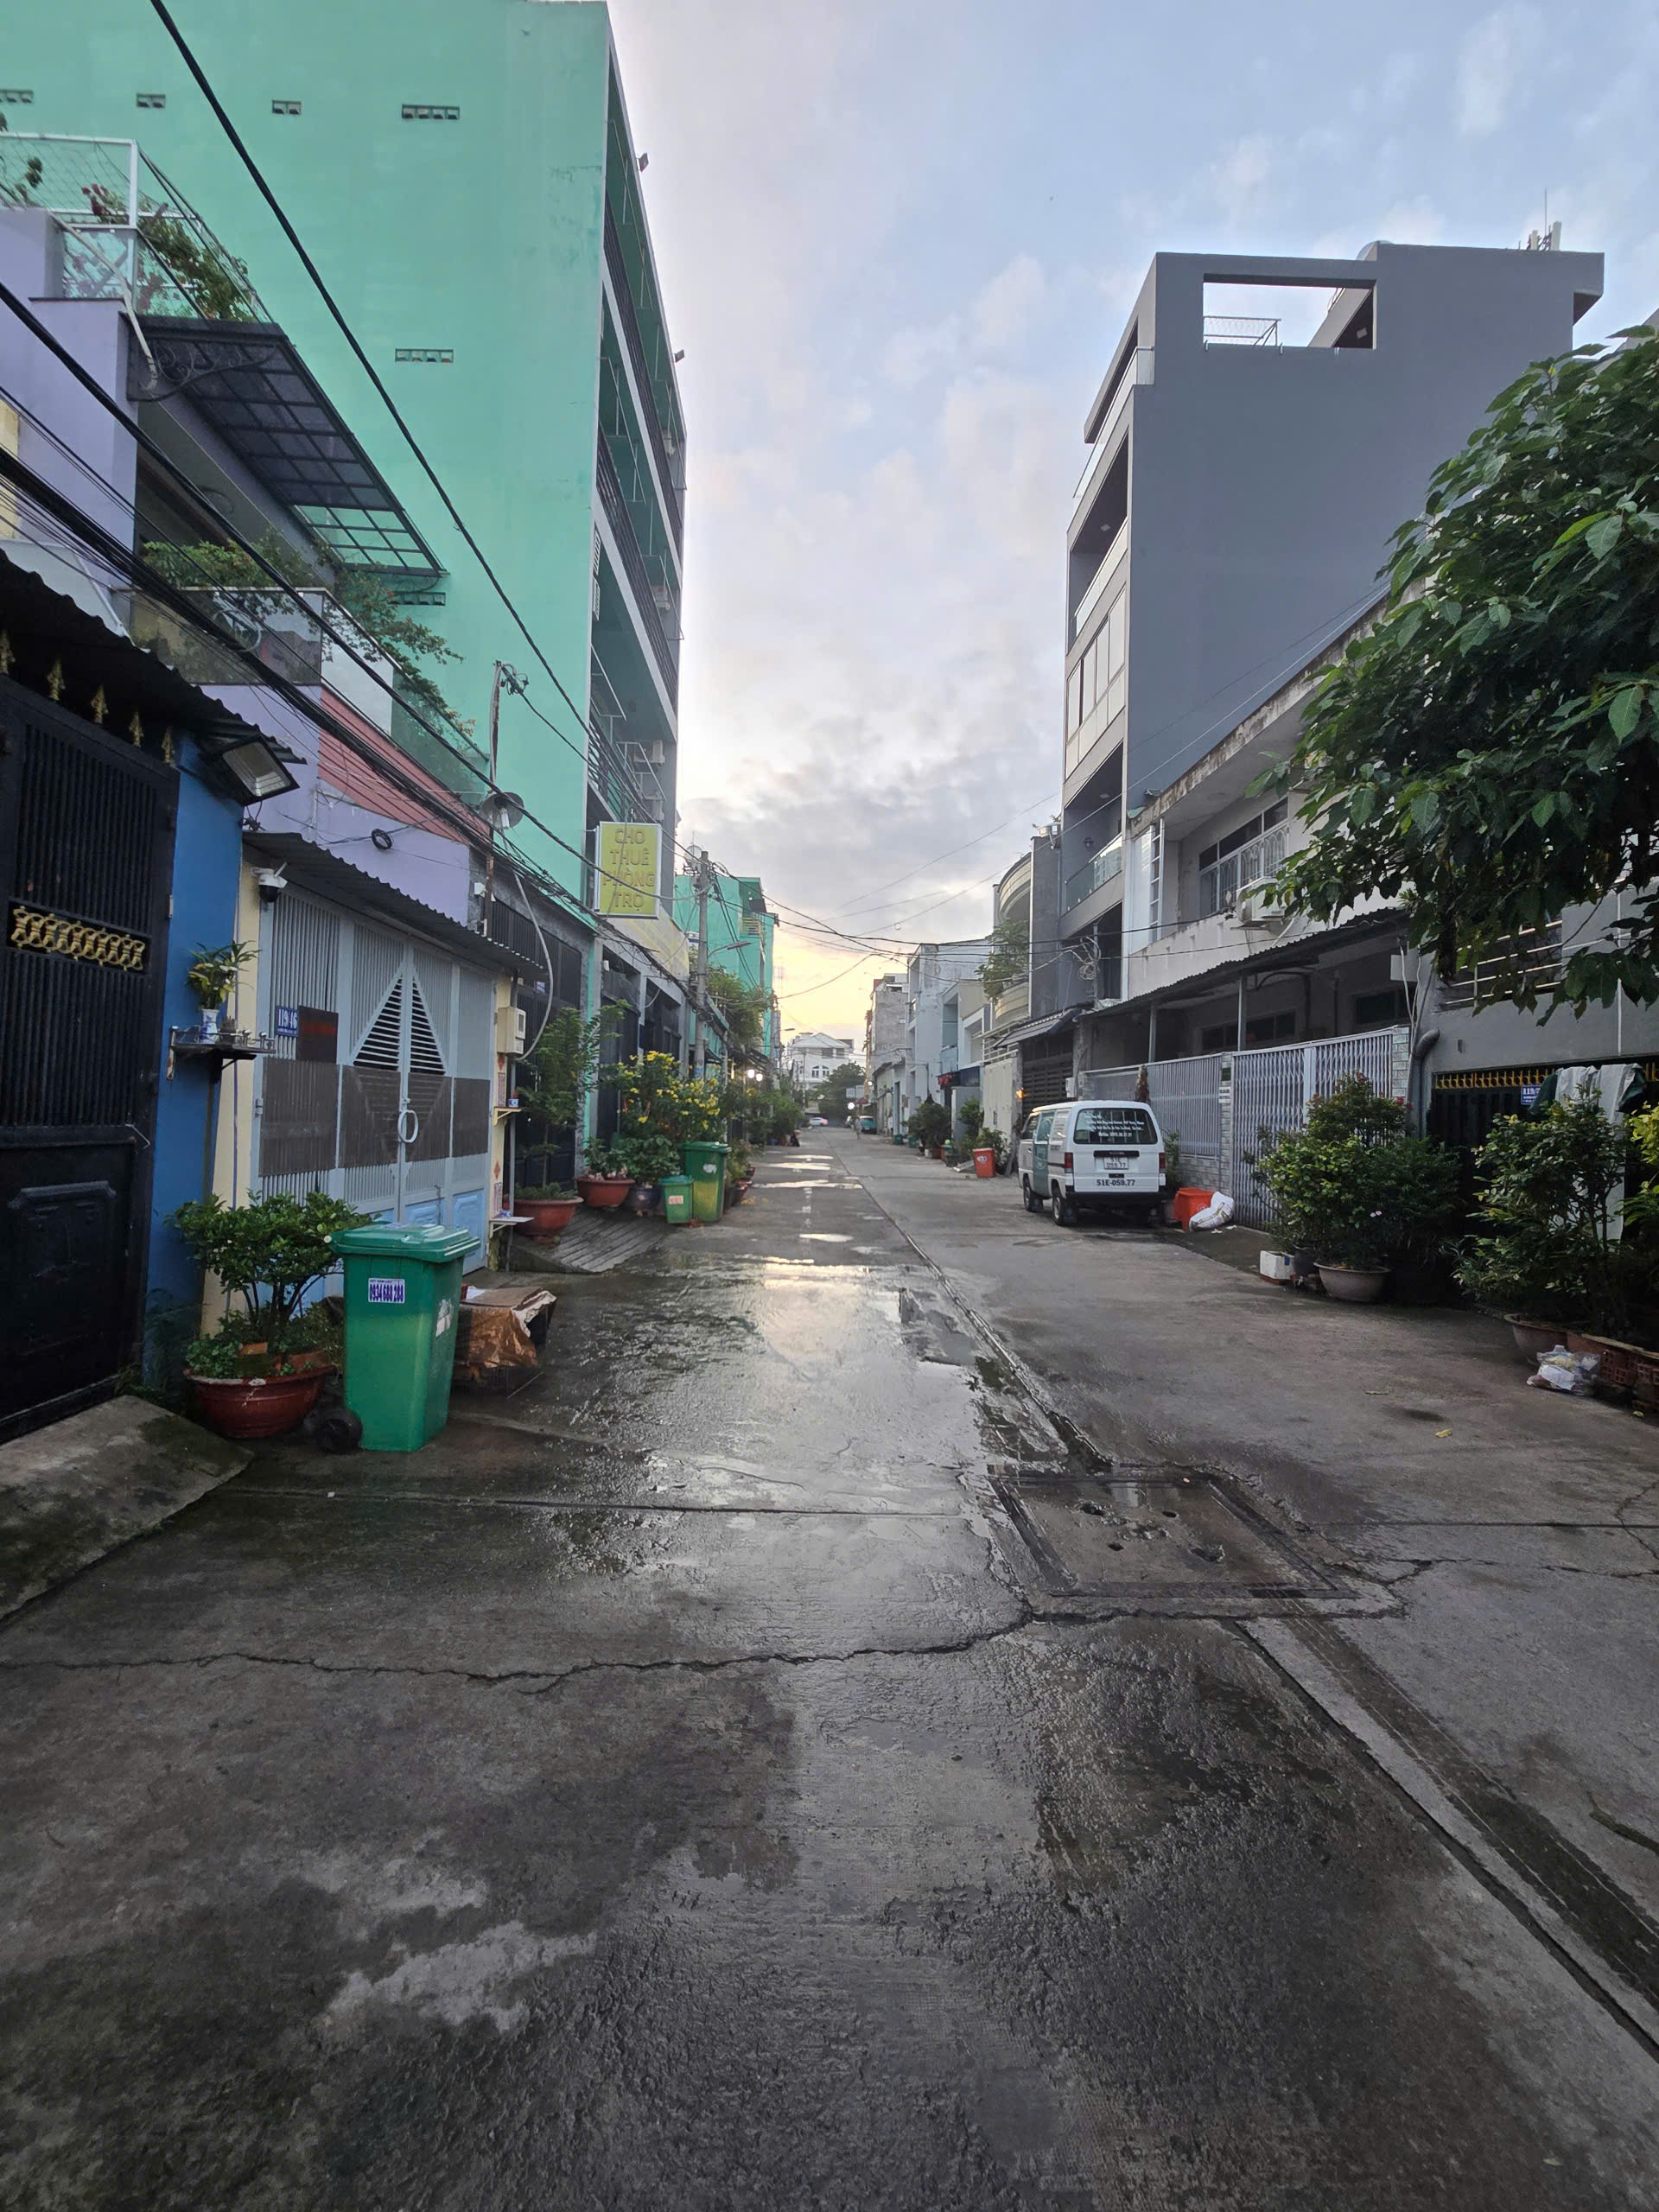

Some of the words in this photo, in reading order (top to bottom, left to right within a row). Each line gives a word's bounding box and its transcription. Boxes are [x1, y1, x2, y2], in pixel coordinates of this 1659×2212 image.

[614, 828, 645, 844] CHO
[609, 848, 650, 866] THUÊ
[602, 867, 655, 887] PHÒNG
[614, 892, 644, 912] TRỌ
